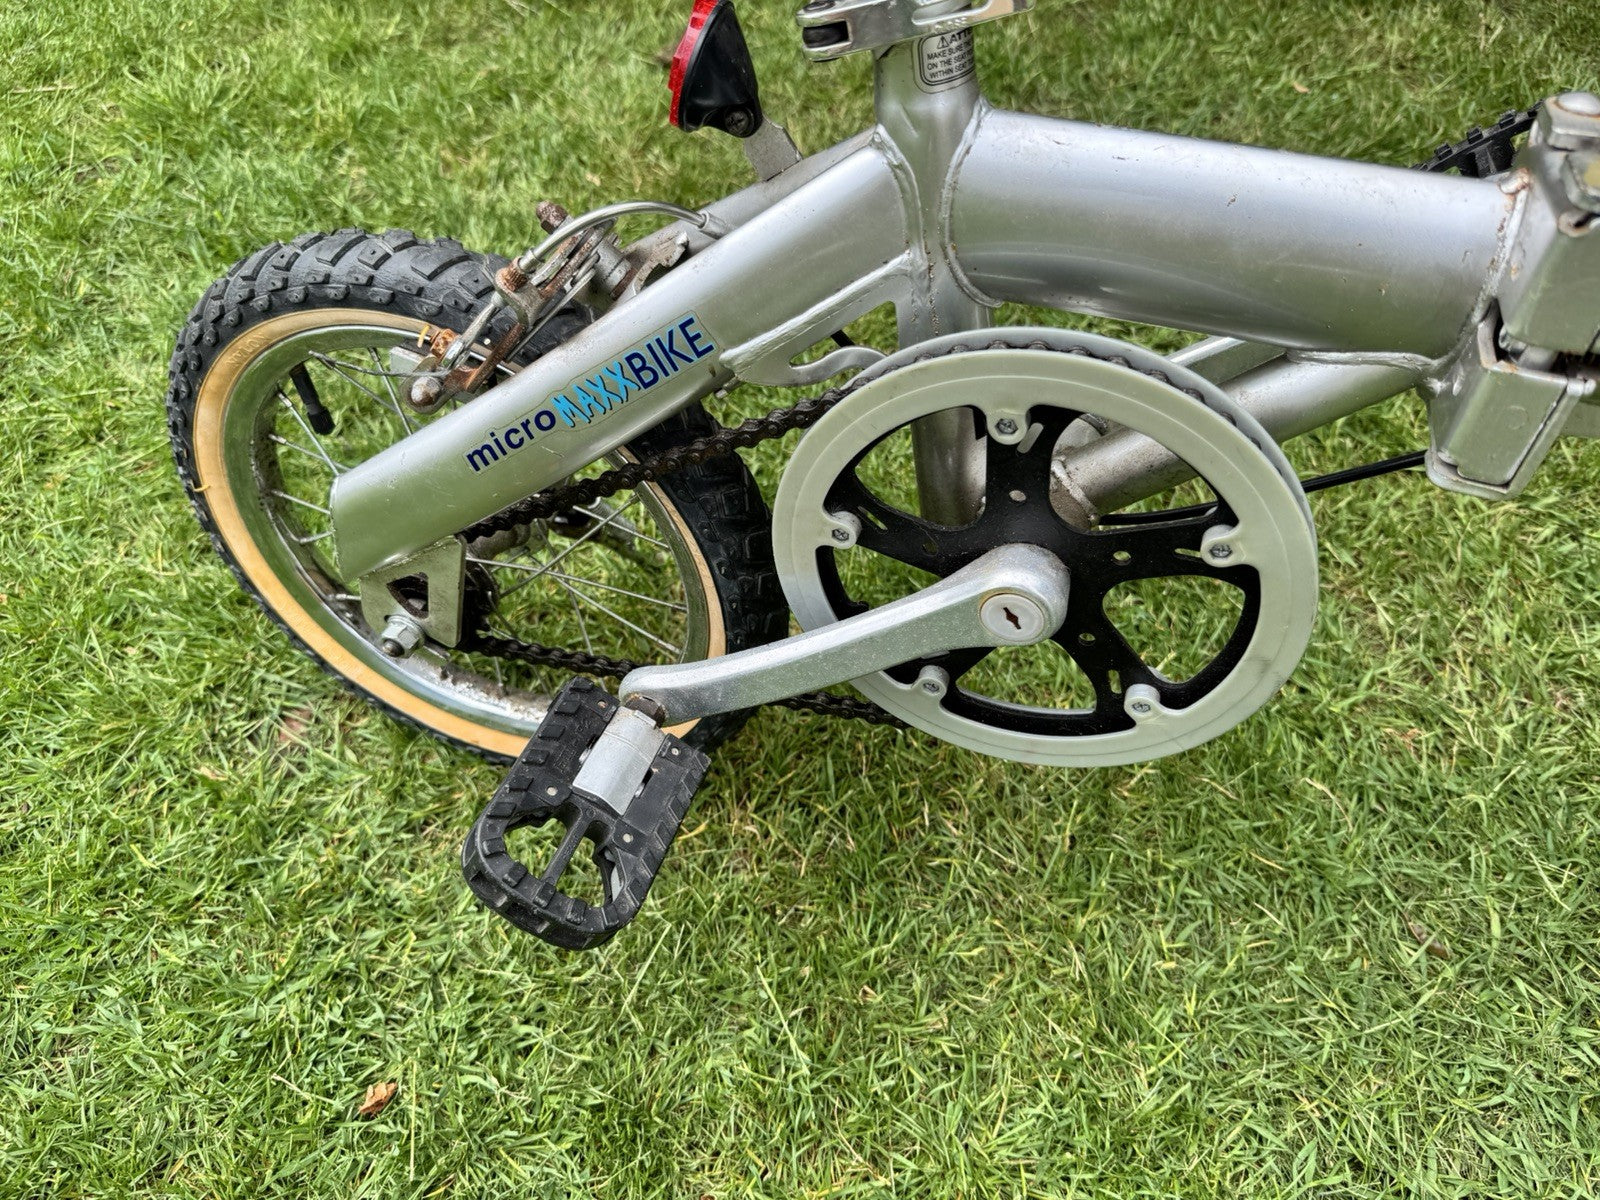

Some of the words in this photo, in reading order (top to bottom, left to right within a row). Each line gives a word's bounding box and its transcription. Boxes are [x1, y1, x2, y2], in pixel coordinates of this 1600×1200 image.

[926, 50, 947, 60] MAKE
[948, 43, 963, 55] SURE
[927, 62, 938, 71] ON
[940, 57, 952, 68] THE
[954, 51, 967, 63] SEAT
[930, 67, 953, 79] WITHIN
[955, 61, 967, 72] SEAT
